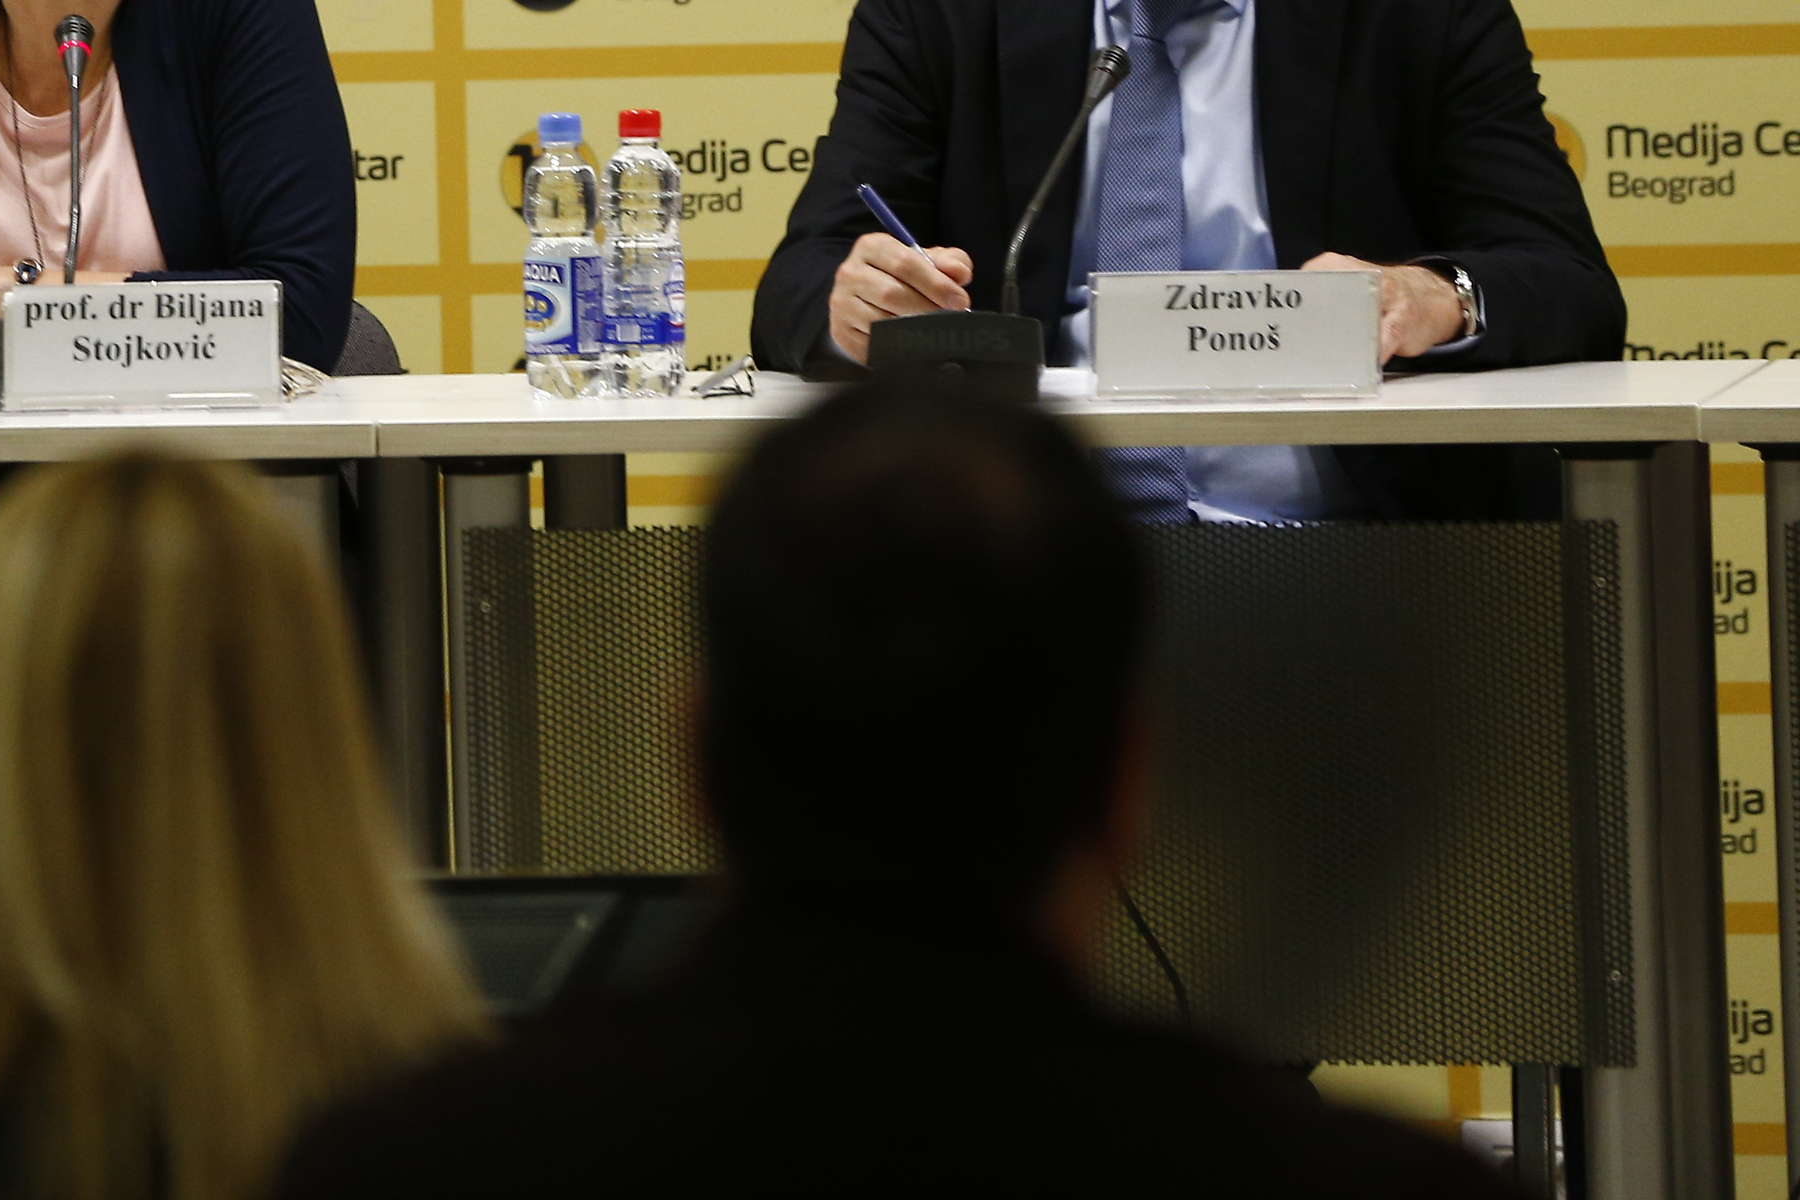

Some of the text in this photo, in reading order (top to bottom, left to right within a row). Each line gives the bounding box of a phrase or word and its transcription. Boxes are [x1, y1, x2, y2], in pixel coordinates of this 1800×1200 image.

[672, 139, 750, 182] edija
[1606, 122, 1744, 167] Medija
[354, 149, 404, 181] tar
[680, 186, 744, 220] grad
[1607, 170, 1735, 204] Beograd
[25, 293, 265, 328] prof. dr Biljana
[1165, 282, 1303, 311] Zdravko
[73, 333, 216, 368] Stojković
[1186, 322, 1281, 352] Ponoš
